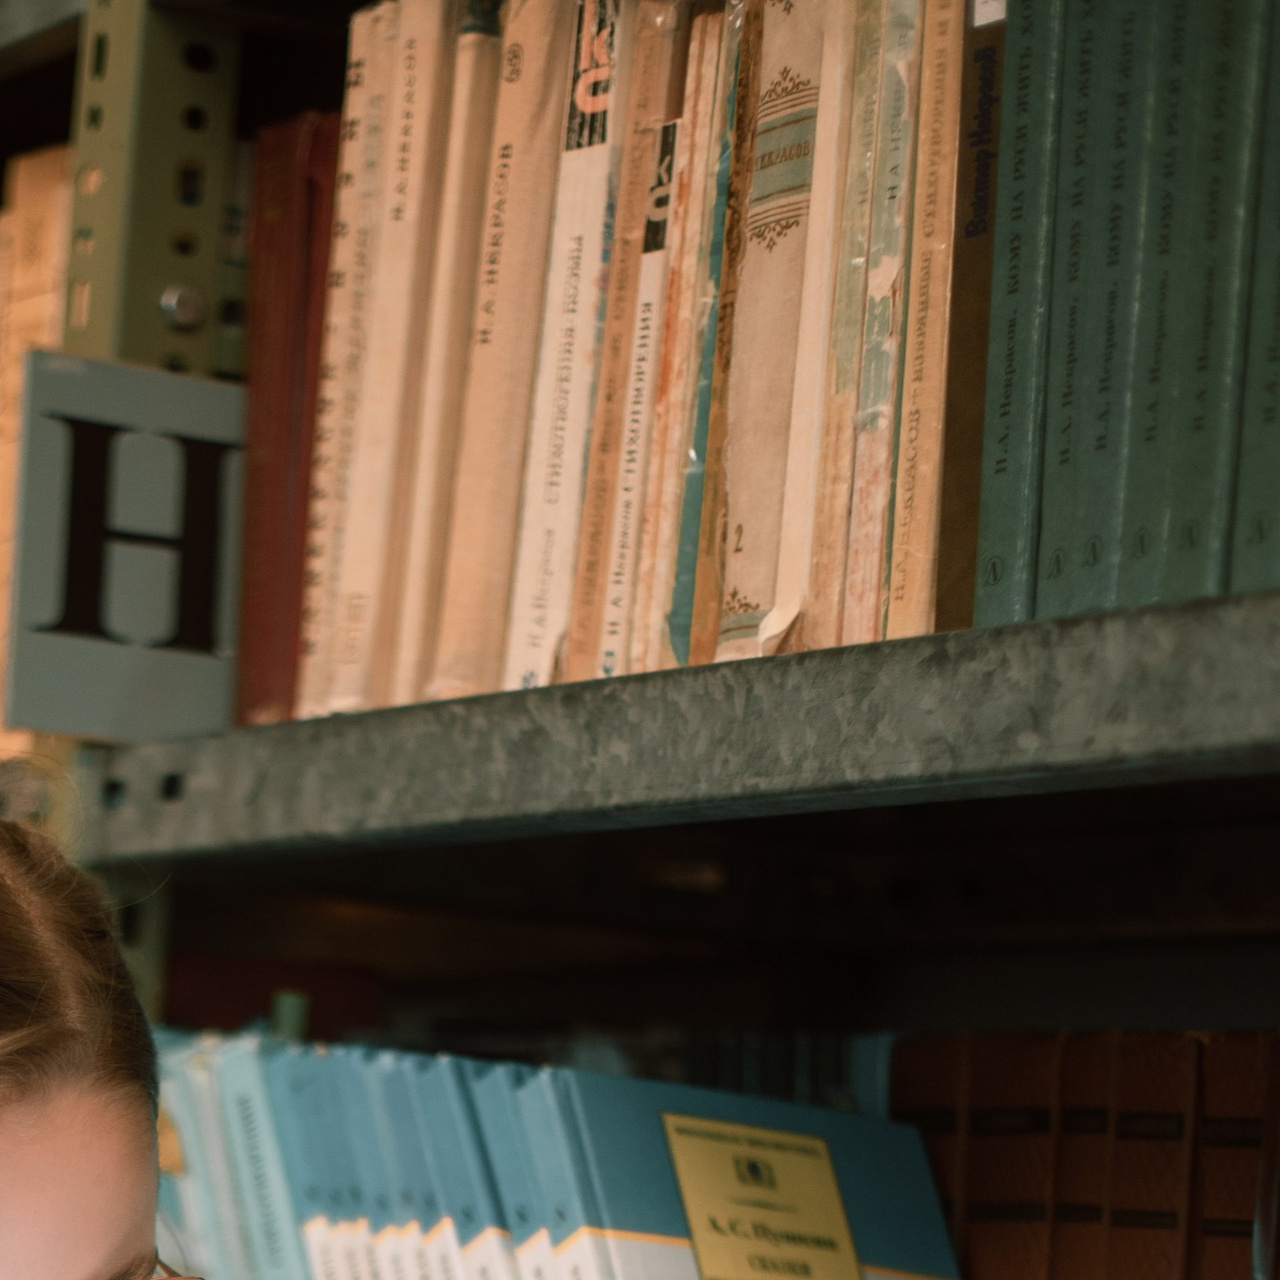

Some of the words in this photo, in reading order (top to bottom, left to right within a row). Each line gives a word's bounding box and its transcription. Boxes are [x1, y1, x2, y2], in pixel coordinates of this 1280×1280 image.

[1017, 45, 1033, 113] ЖИТЬ
[1013, 124, 1028, 181] РУСИ
[483, 142, 513, 285] НЕКРАСОВ
[1010, 189, 1025, 221] НА
[1006, 231, 1021, 296] КОМУ
[26, 411, 243, 656] Н
